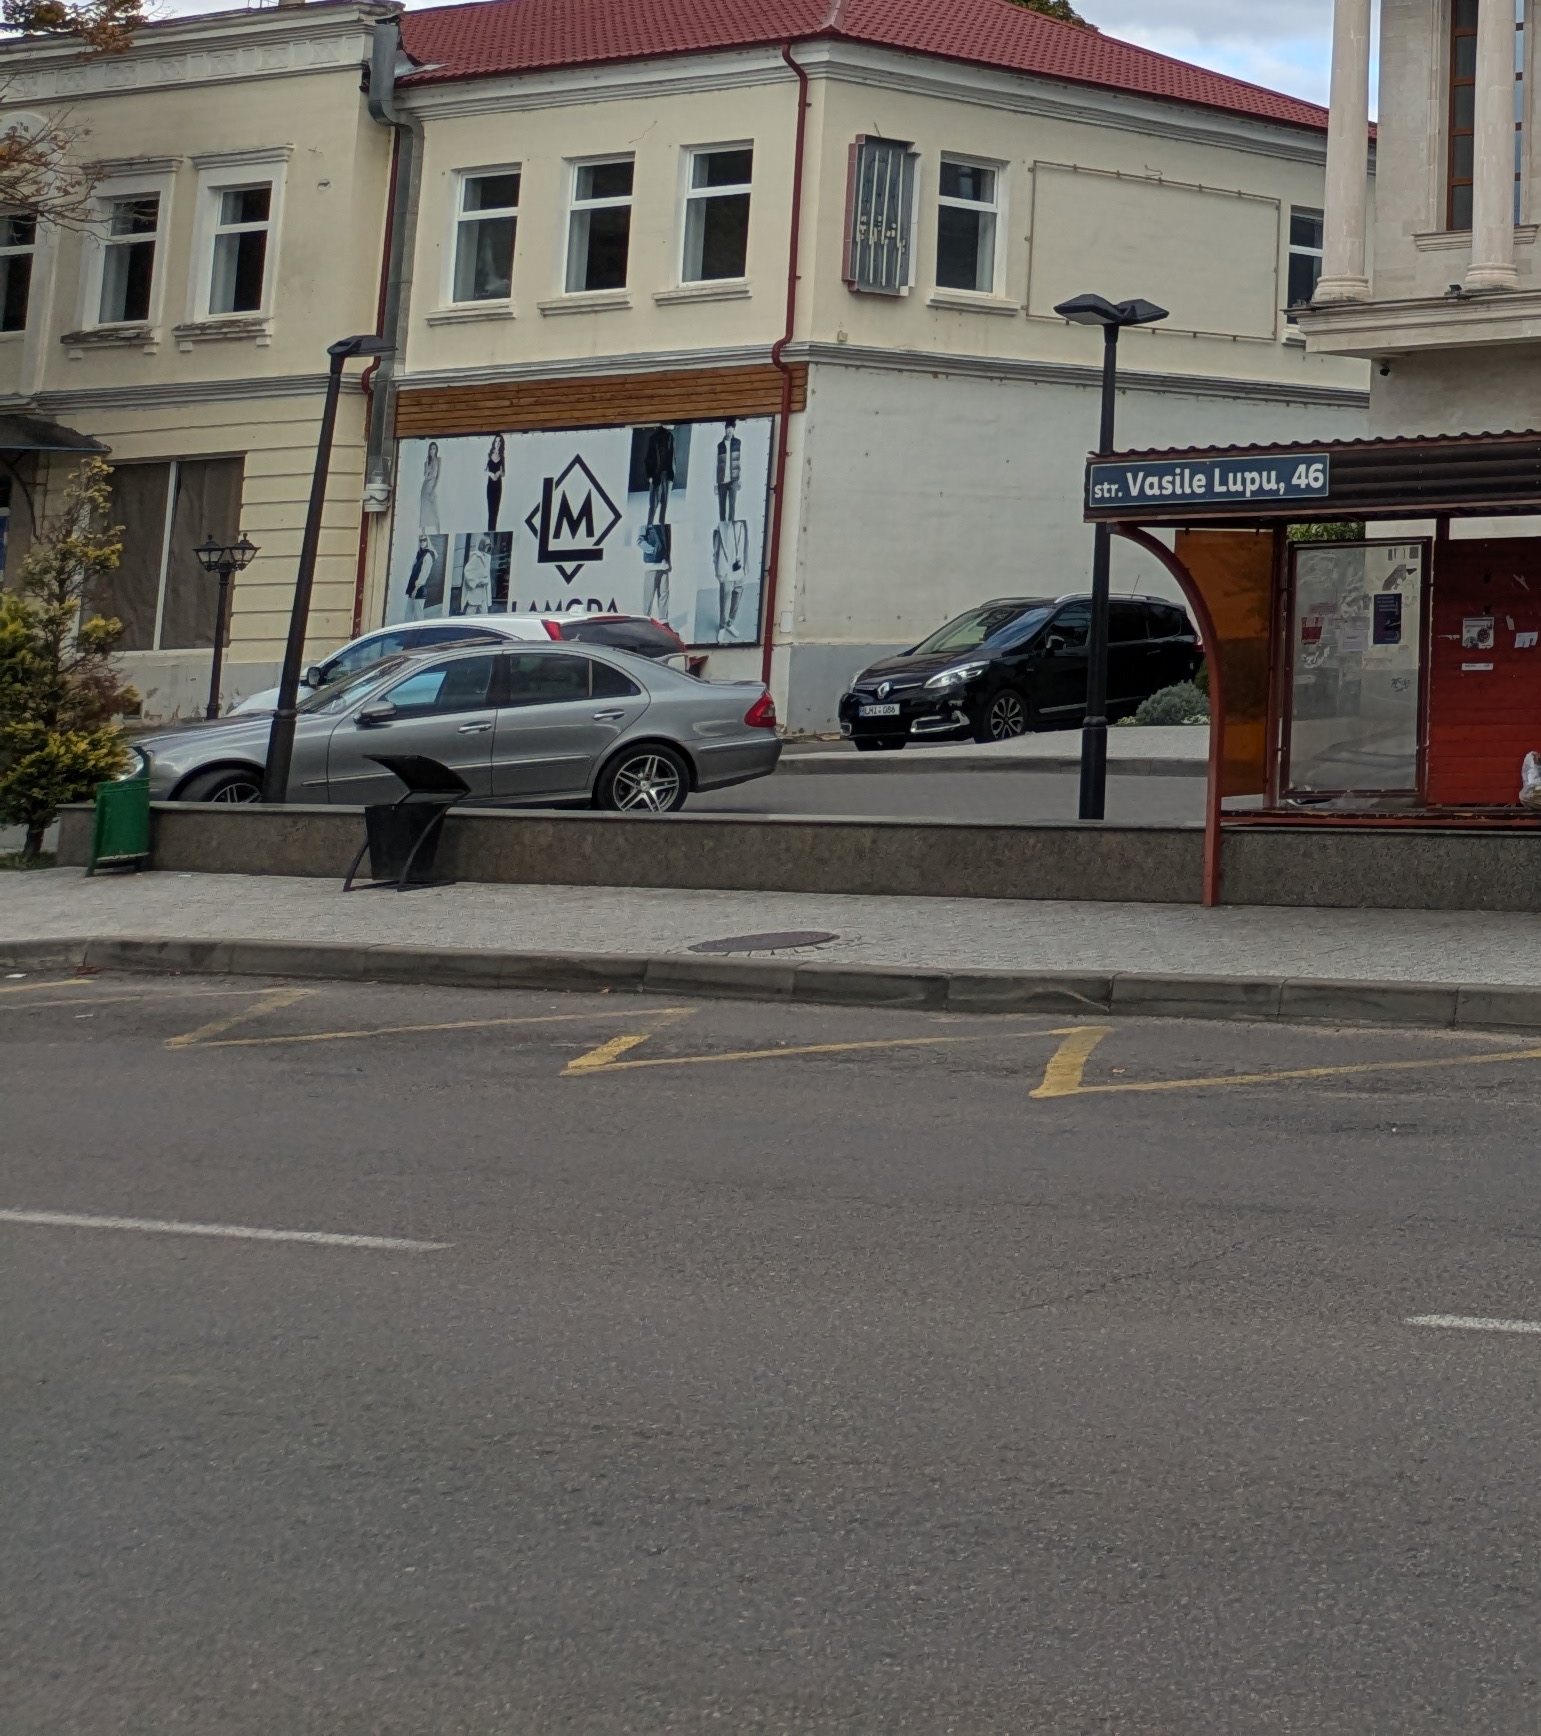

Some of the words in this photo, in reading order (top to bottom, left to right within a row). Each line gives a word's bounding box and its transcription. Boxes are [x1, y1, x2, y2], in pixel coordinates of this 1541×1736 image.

[1094, 482, 1123, 498] str.
[1126, 468, 1207, 497] Vasile
[1213, 468, 1285, 498] Lupu,
[1291, 463, 1324, 489] 46
